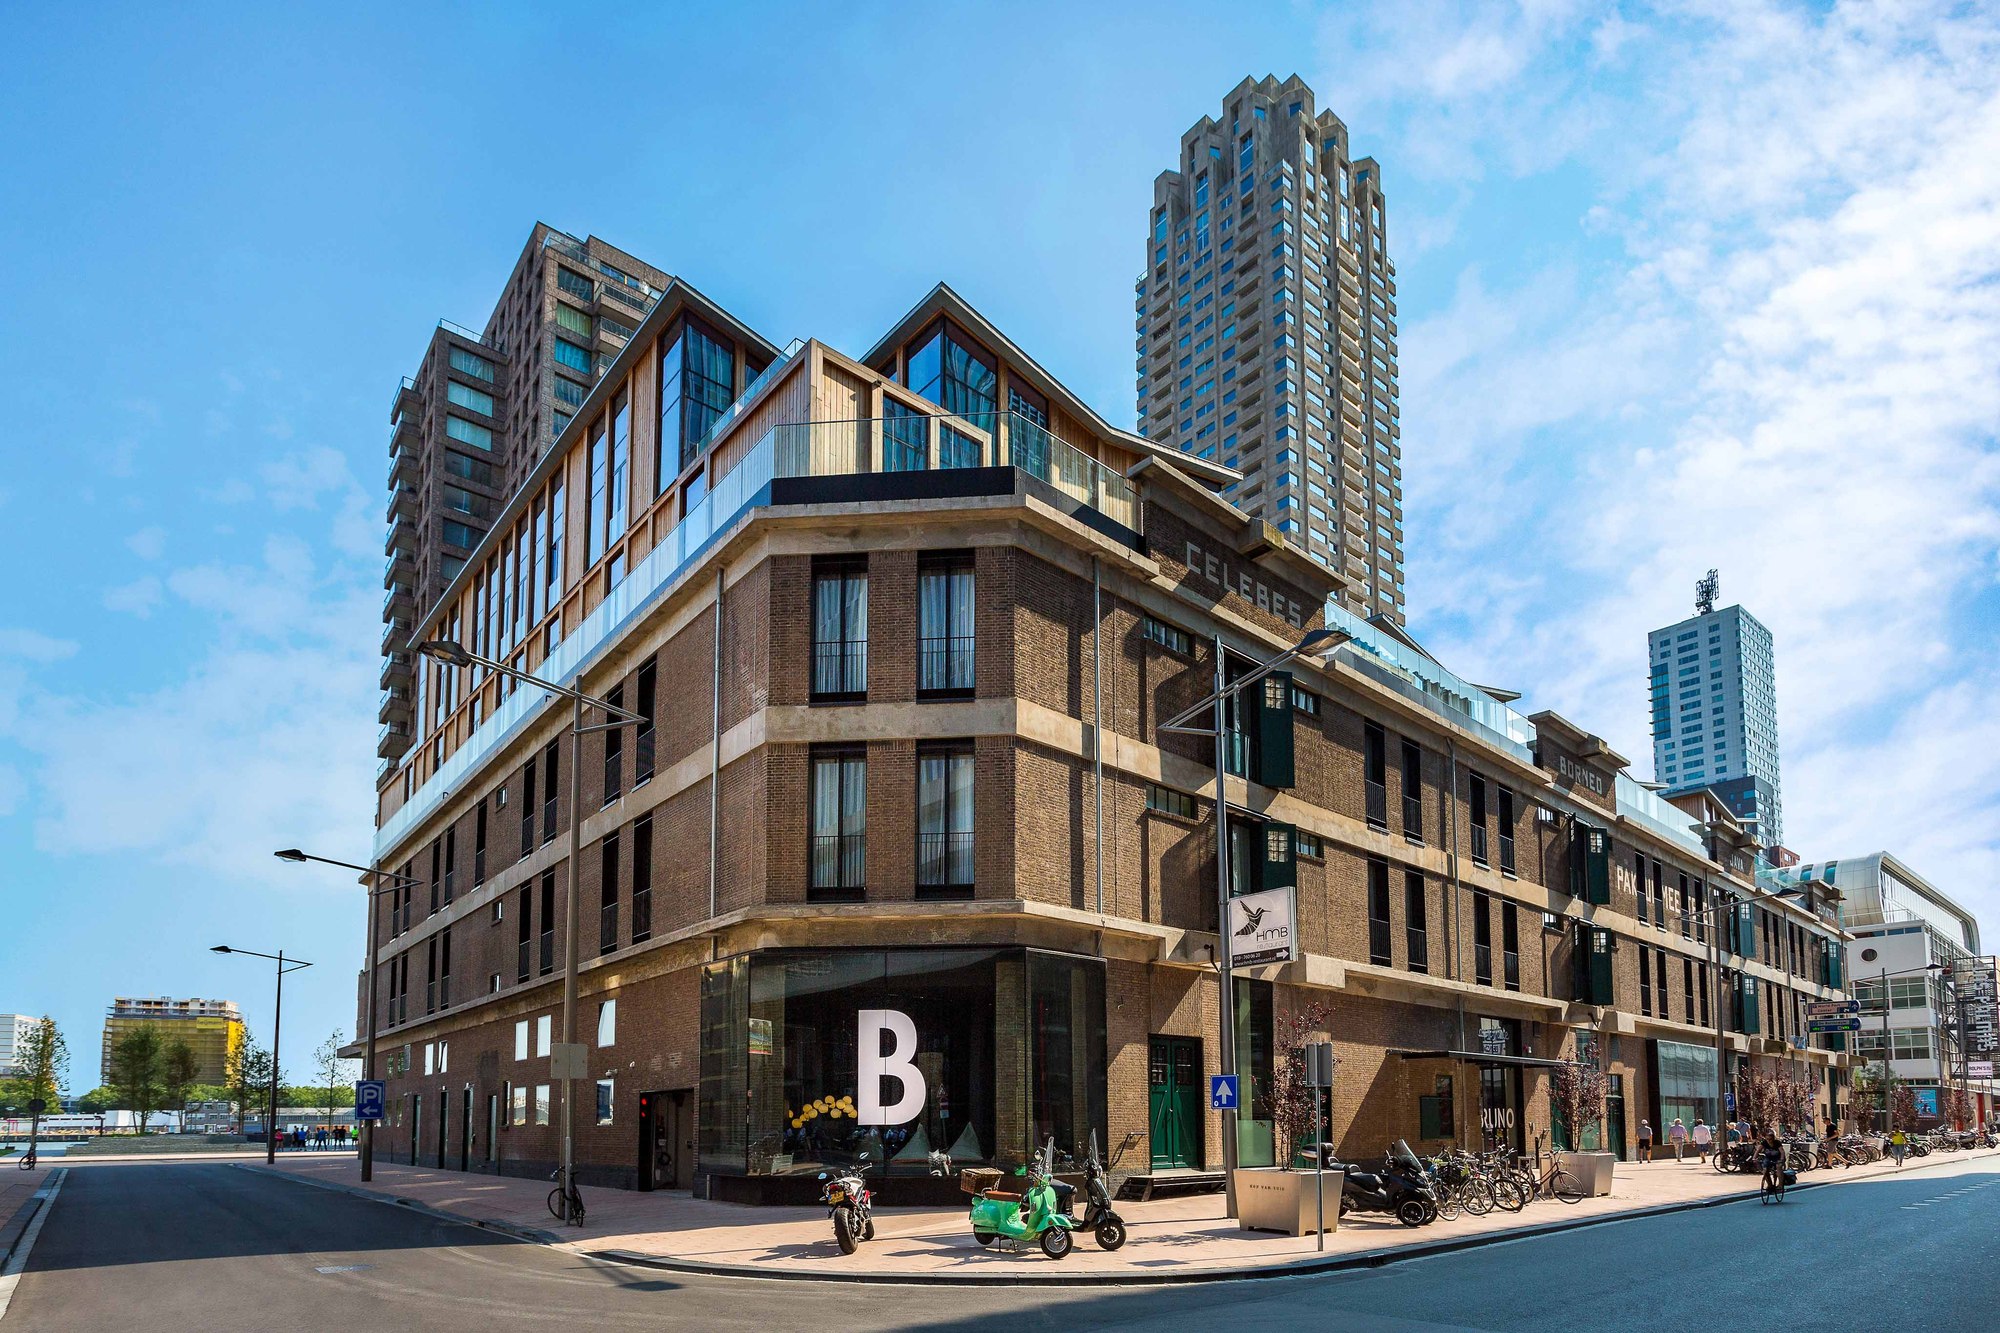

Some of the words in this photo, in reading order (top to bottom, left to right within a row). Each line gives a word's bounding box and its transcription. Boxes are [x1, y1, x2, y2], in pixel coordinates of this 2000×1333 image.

[1186, 541, 1301, 629] CELEBES
[1560, 755, 1603, 795] BORNEO
[1729, 854, 1745, 873] JAVA
[858, 1010, 926, 1125] B
[363, 1089, 378, 1104] P
